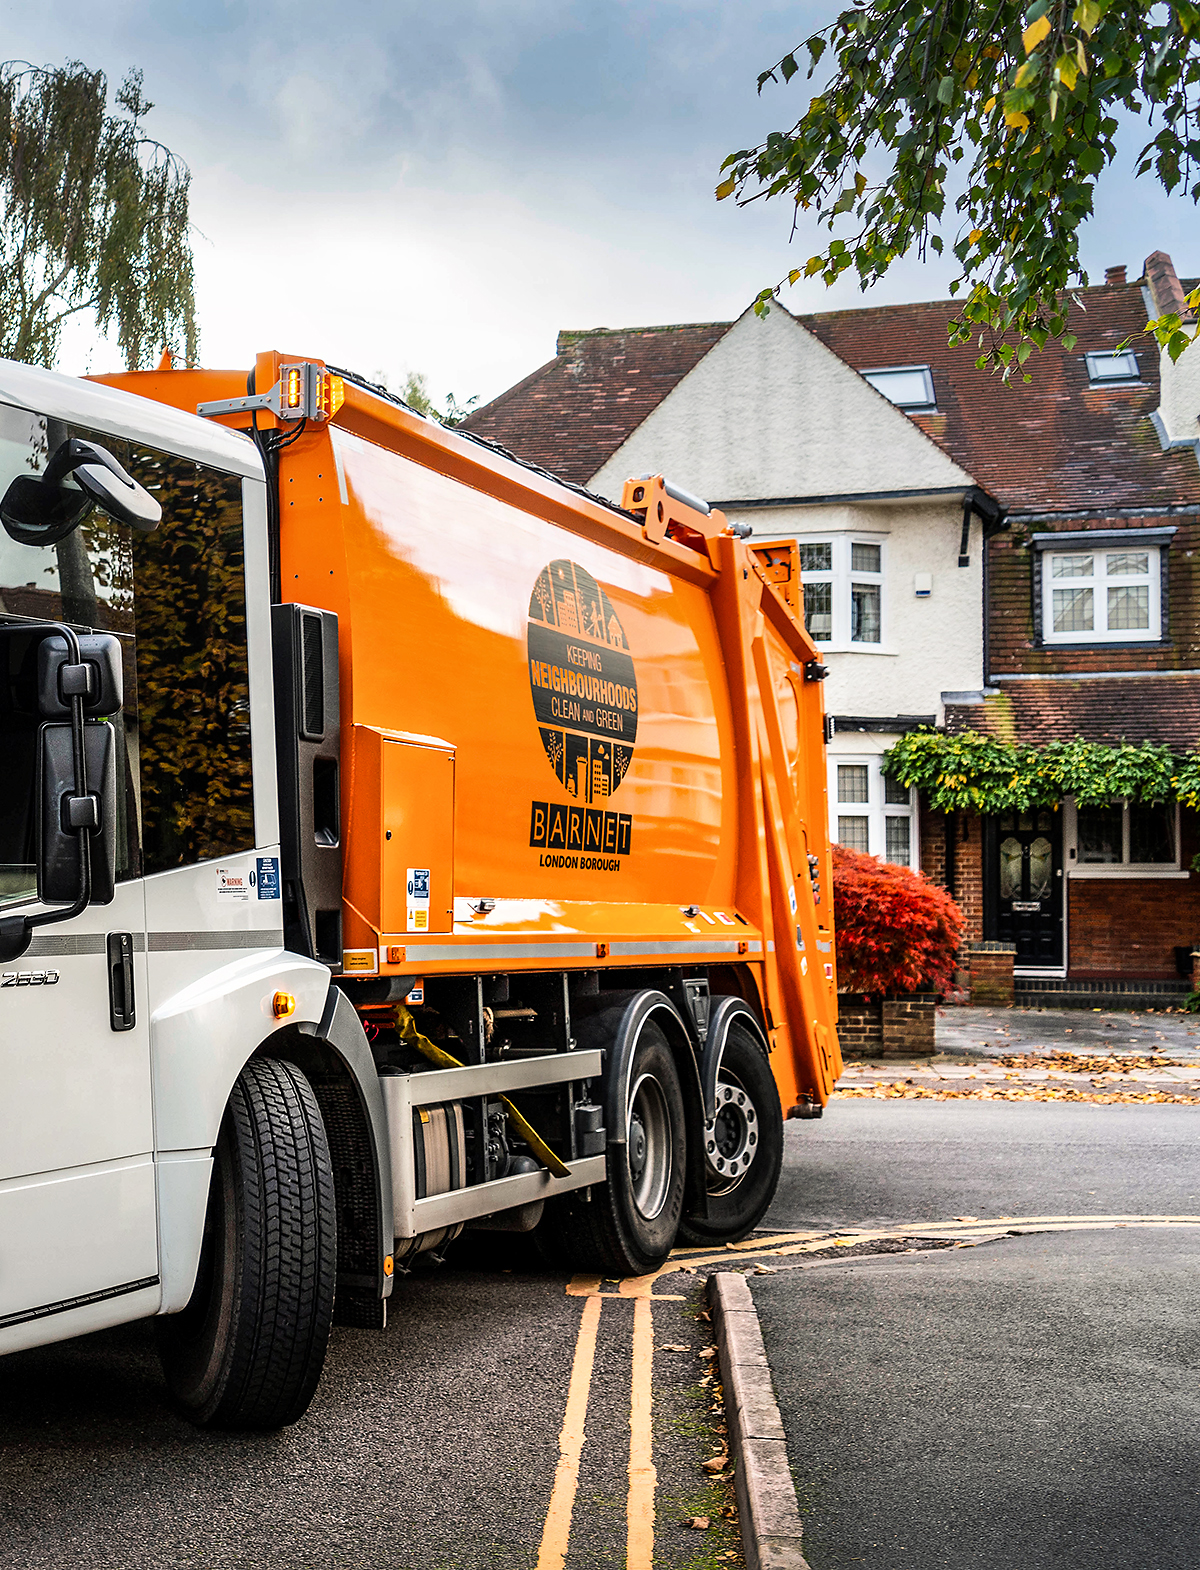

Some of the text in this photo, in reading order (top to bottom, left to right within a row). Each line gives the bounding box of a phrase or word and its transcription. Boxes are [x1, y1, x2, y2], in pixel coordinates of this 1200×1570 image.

[566, 644, 602, 672] KEEPING
[531, 659, 637, 712] NEIGHBOURHOODS
[551, 696, 623, 732] CLEAN AND GREEN
[533, 808, 630, 849] BARNET
[540, 854, 620, 871] LONDON BOROUGH
